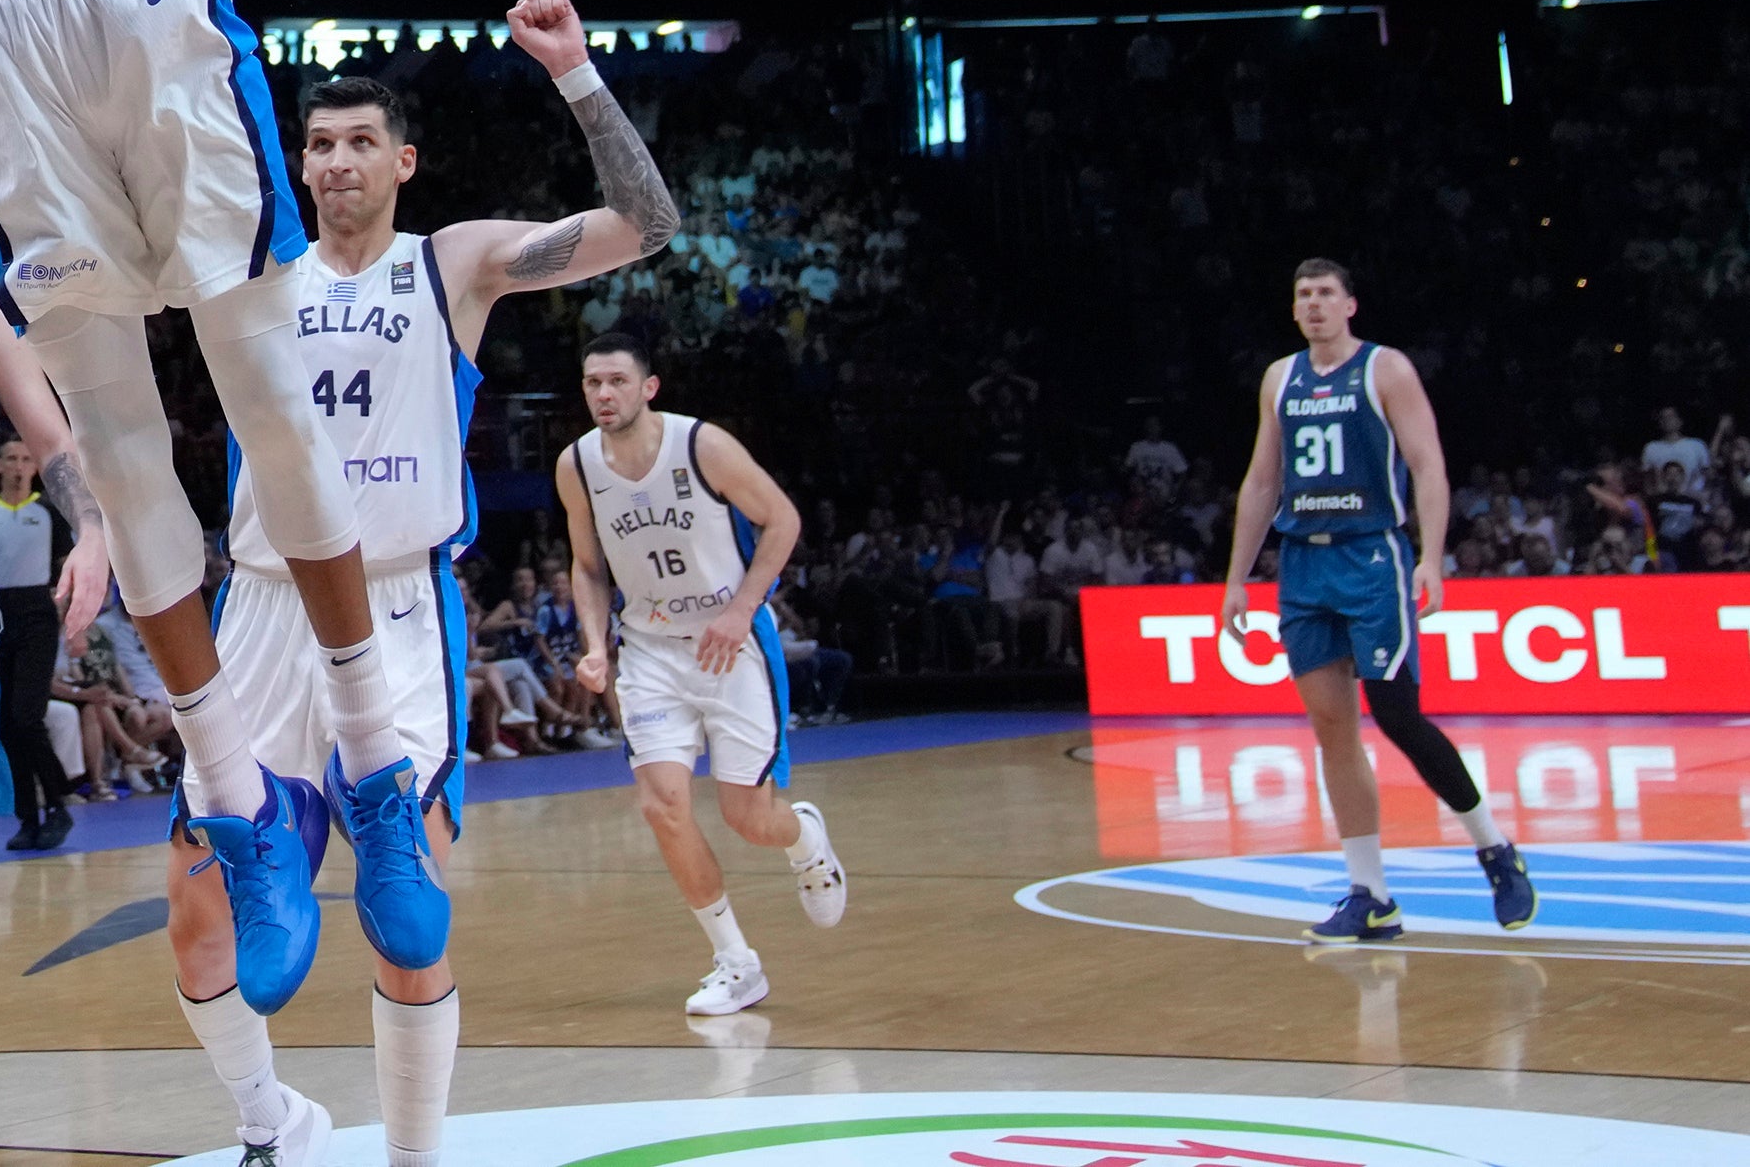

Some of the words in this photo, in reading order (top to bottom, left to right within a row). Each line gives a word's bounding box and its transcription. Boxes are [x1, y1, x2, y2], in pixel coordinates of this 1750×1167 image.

[297, 305, 411, 344] ELLAS
[311, 369, 372, 417] 44
[1285, 394, 1358, 417] SLOVENIJA
[1294, 422, 1345, 478] 31
[609, 507, 695, 540] HELLAS
[646, 549, 687, 580] 16
[1139, 610, 1291, 686] TC
[1418, 604, 1668, 683] TCL
